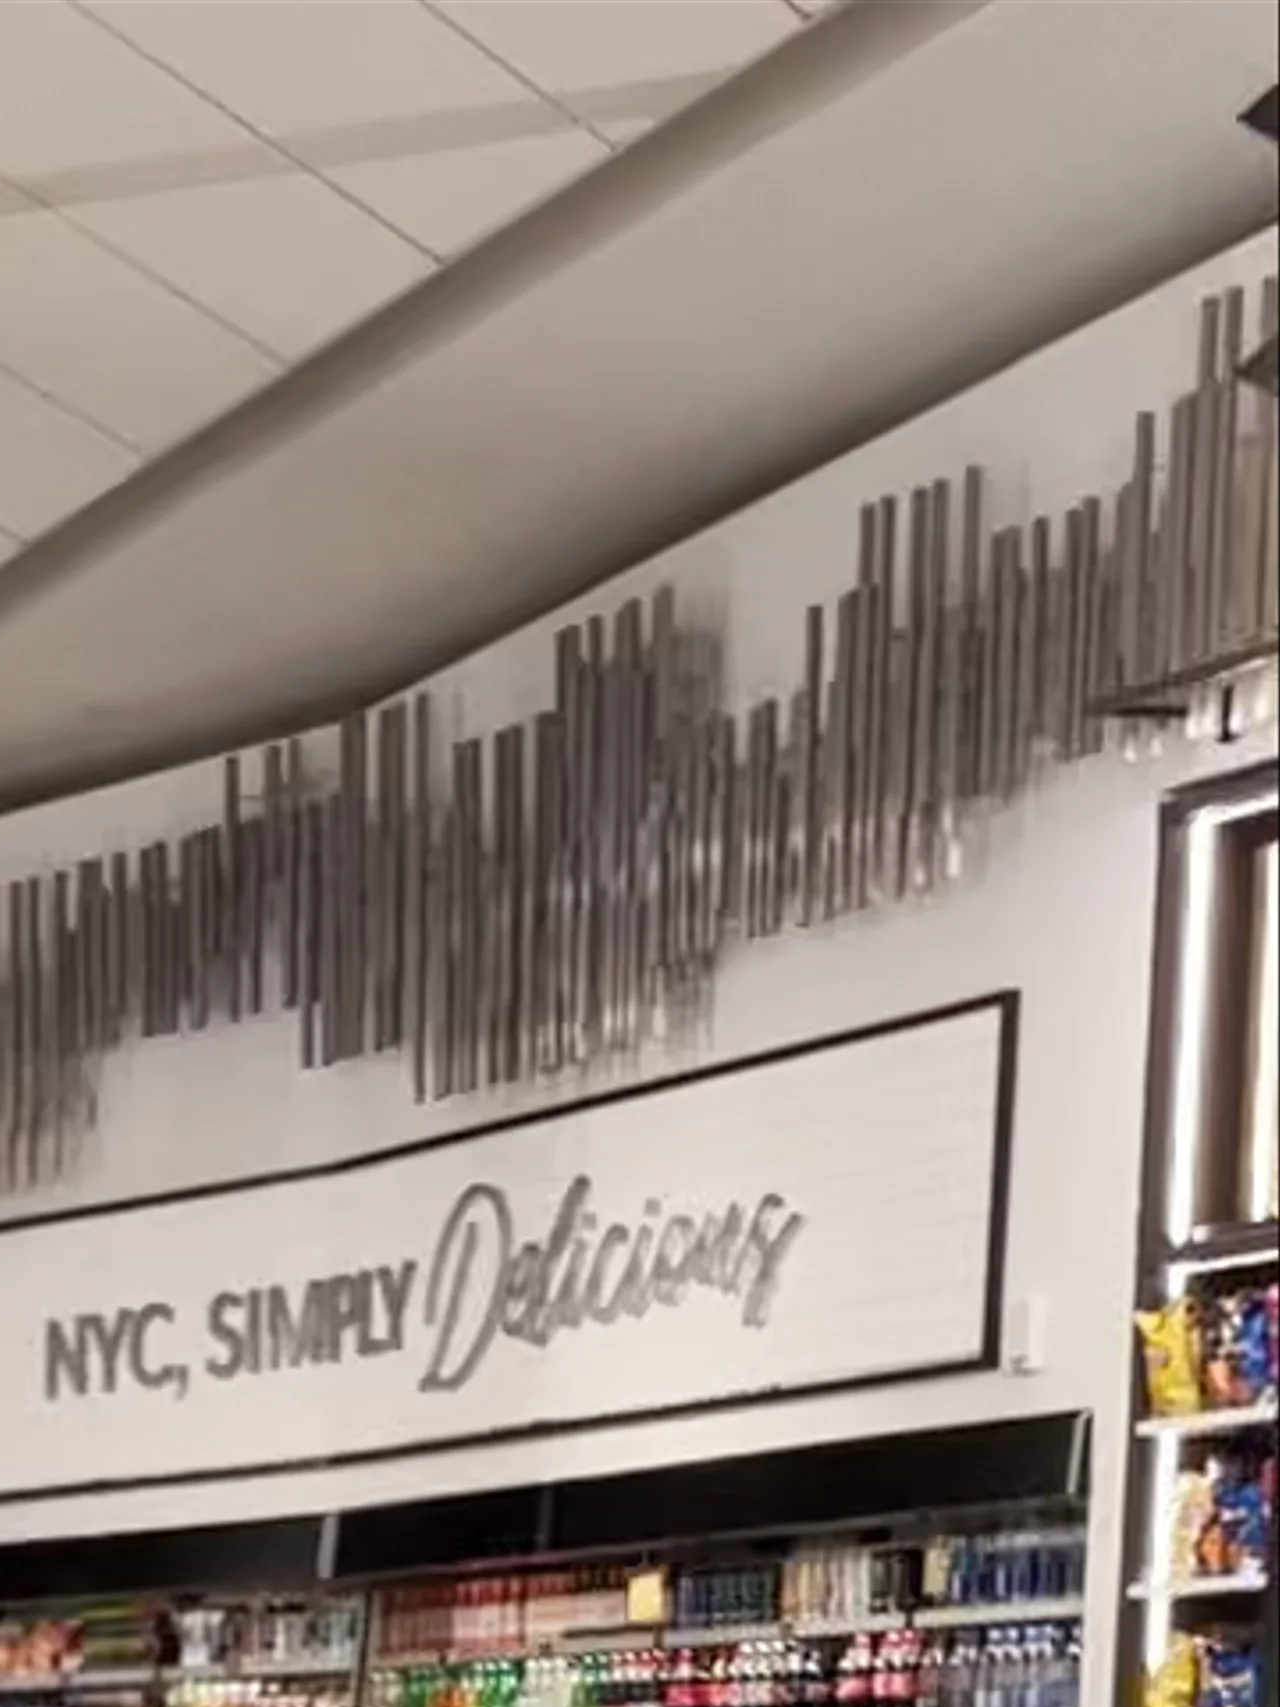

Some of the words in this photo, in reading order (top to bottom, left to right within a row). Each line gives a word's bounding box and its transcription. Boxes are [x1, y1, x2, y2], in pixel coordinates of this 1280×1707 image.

[44, 1303, 190, 1400] NYC,
[204, 1259, 418, 1379] SIMPLY
[419, 1173, 806, 1393] Delicious
